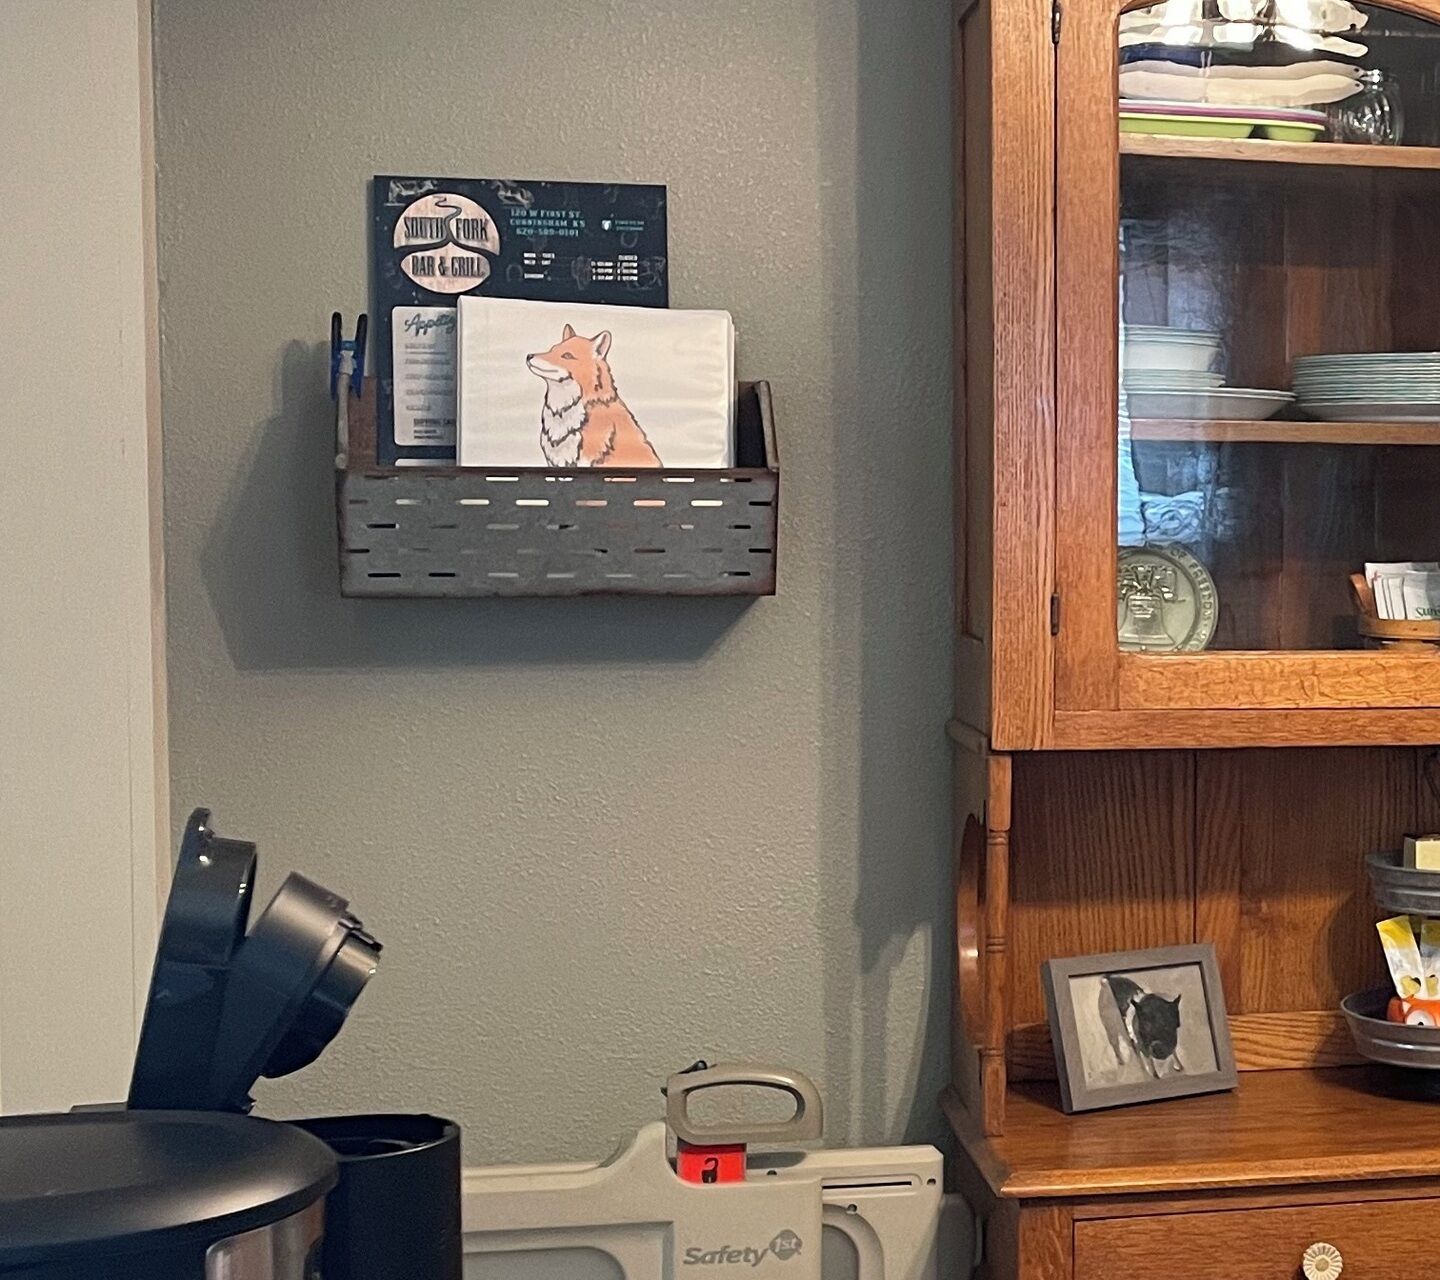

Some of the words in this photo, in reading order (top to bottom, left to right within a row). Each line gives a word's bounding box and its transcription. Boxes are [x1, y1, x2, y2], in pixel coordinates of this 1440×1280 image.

[403, 216, 444, 239] SOUTH
[455, 218, 488, 241] FORK
[411, 255, 435, 277] BAR
[438, 256, 446, 276] &
[451, 256, 486, 277] GRILL
[683, 1245, 769, 1267] Safety
[774, 1236, 799, 1253] 1st
